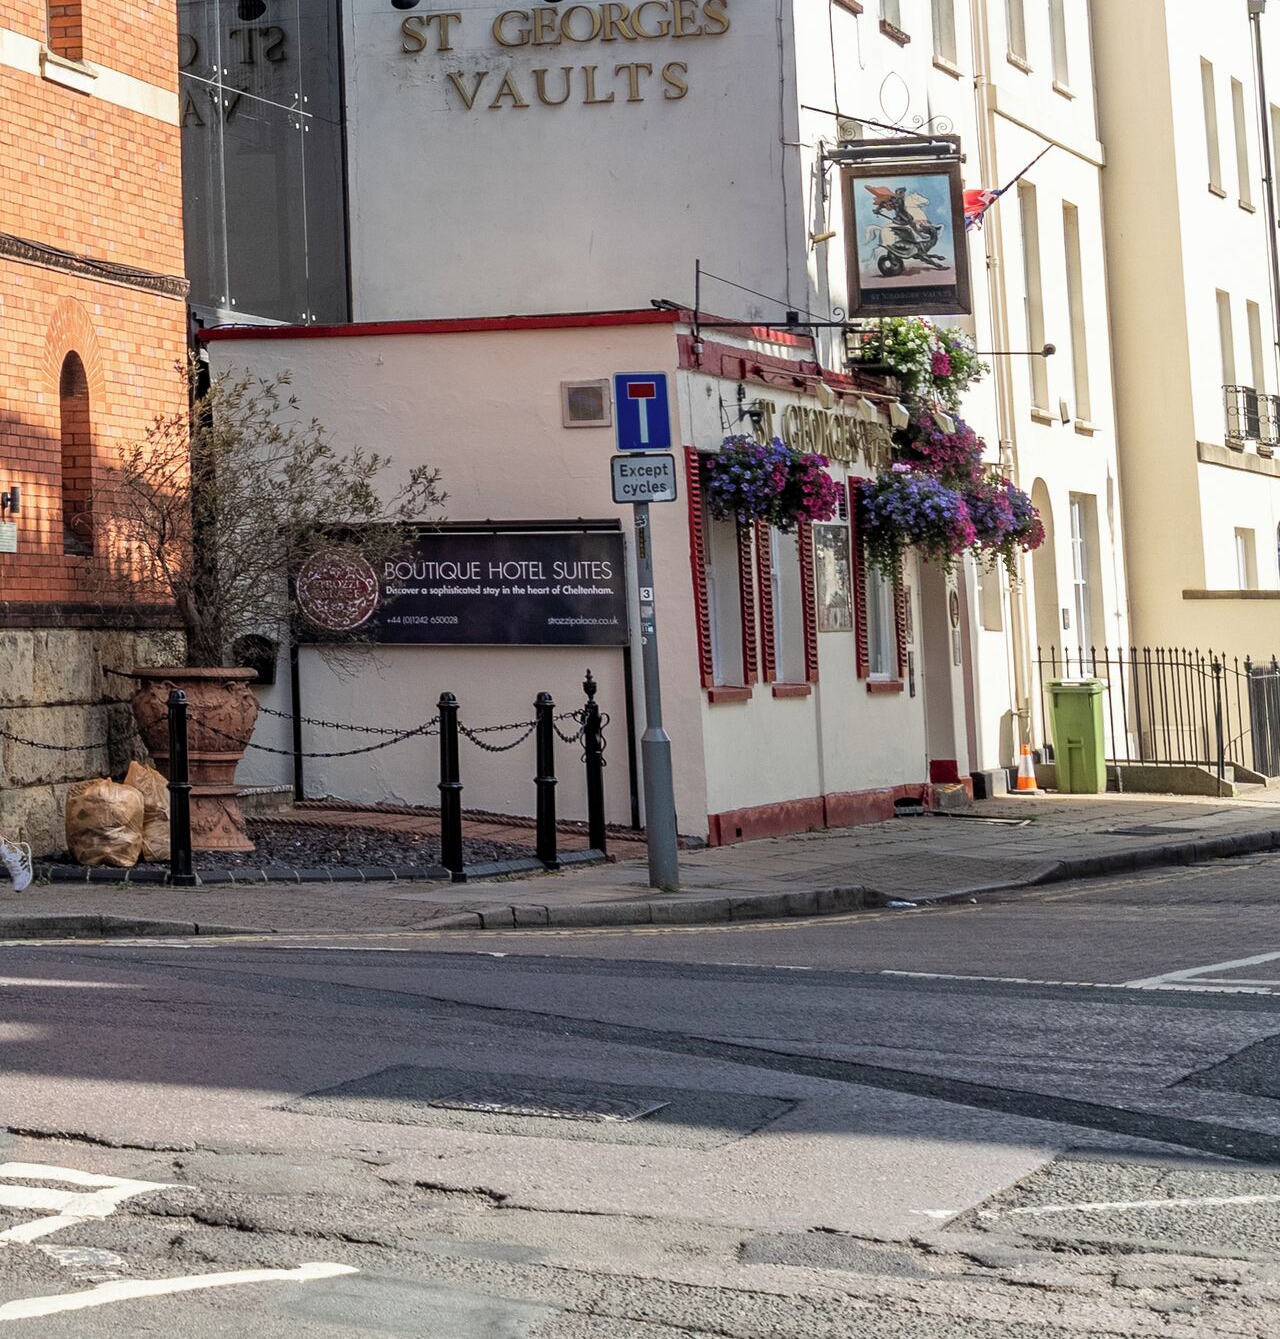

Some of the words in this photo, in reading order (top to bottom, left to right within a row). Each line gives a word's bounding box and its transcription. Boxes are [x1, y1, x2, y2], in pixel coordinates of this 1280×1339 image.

[401, 12, 462, 54] ST
[446, 61, 689, 110] VAULTS
[620, 463, 669, 478] Except
[623, 480, 667, 496] cycles
[384, 561, 481, 581] BOUTIQUE
[489, 561, 546, 580] HOTEL
[552, 561, 613, 580] SUITES
[385, 585, 419, 595] Discover
[421, 587, 428, 595] a
[429, 585, 481, 597] sophisticated
[483, 585, 500, 597] stay
[502, 585, 510, 595] in
[512, 585, 525, 595] the
[527, 585, 550, 595] heart
[551, 585, 560, 595] of
[562, 585, 614, 595] Cheltenham.
[643, 589, 650, 599] 3
[387, 616, 401, 624] +44
[547, 615, 619, 627] strozzipalace.co.uk
